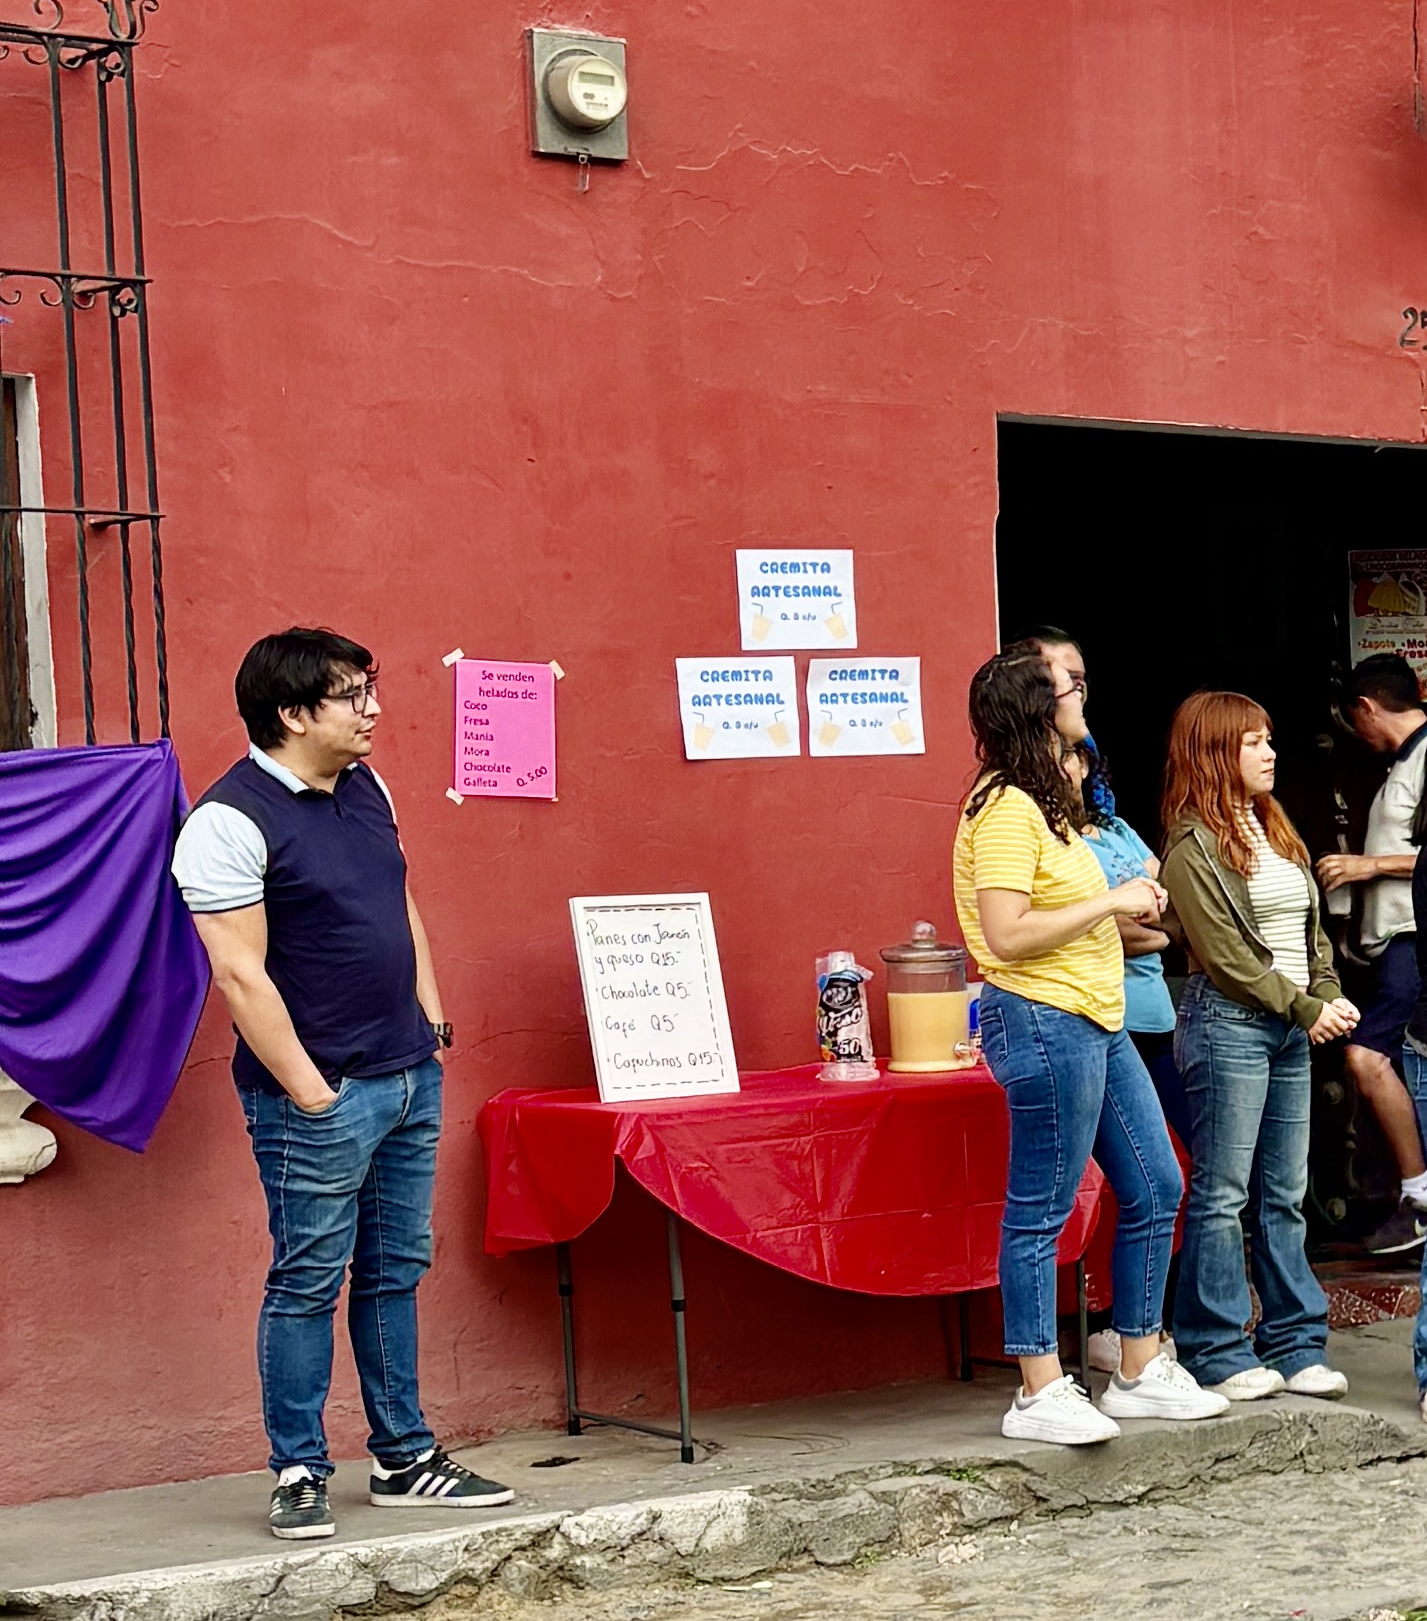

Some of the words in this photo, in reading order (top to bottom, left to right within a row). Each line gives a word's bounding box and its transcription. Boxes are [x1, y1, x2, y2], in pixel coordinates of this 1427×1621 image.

[759, 561, 831, 574] CREMITA
[751, 585, 842, 598] ARTESANAL
[481, 670, 494, 680] Se
[497, 672, 535, 682] venden
[699, 669, 773, 683] CREMITA
[828, 668, 900, 682] CREMITA
[478, 687, 519, 699] helados
[521, 689, 538, 700] de:
[692, 692, 785, 706] ARTESANAL
[819, 691, 909, 705] ARTESANAL
[463, 700, 488, 711] Coco
[464, 716, 490, 726] Fresa
[464, 746, 490, 757] Mora
[463, 762, 512, 774] Chocolate
[527, 765, 548, 782] 5.00
[463, 777, 498, 788] Galleta
[586, 919, 627, 946] Panes
[631, 933, 651, 945] con
[595, 955, 605, 974] y
[607, 952, 644, 971] queso
[601, 980, 661, 1000] Chocolate
[605, 1015, 636, 1039] Café
[838, 1037, 860, 1055] 50
